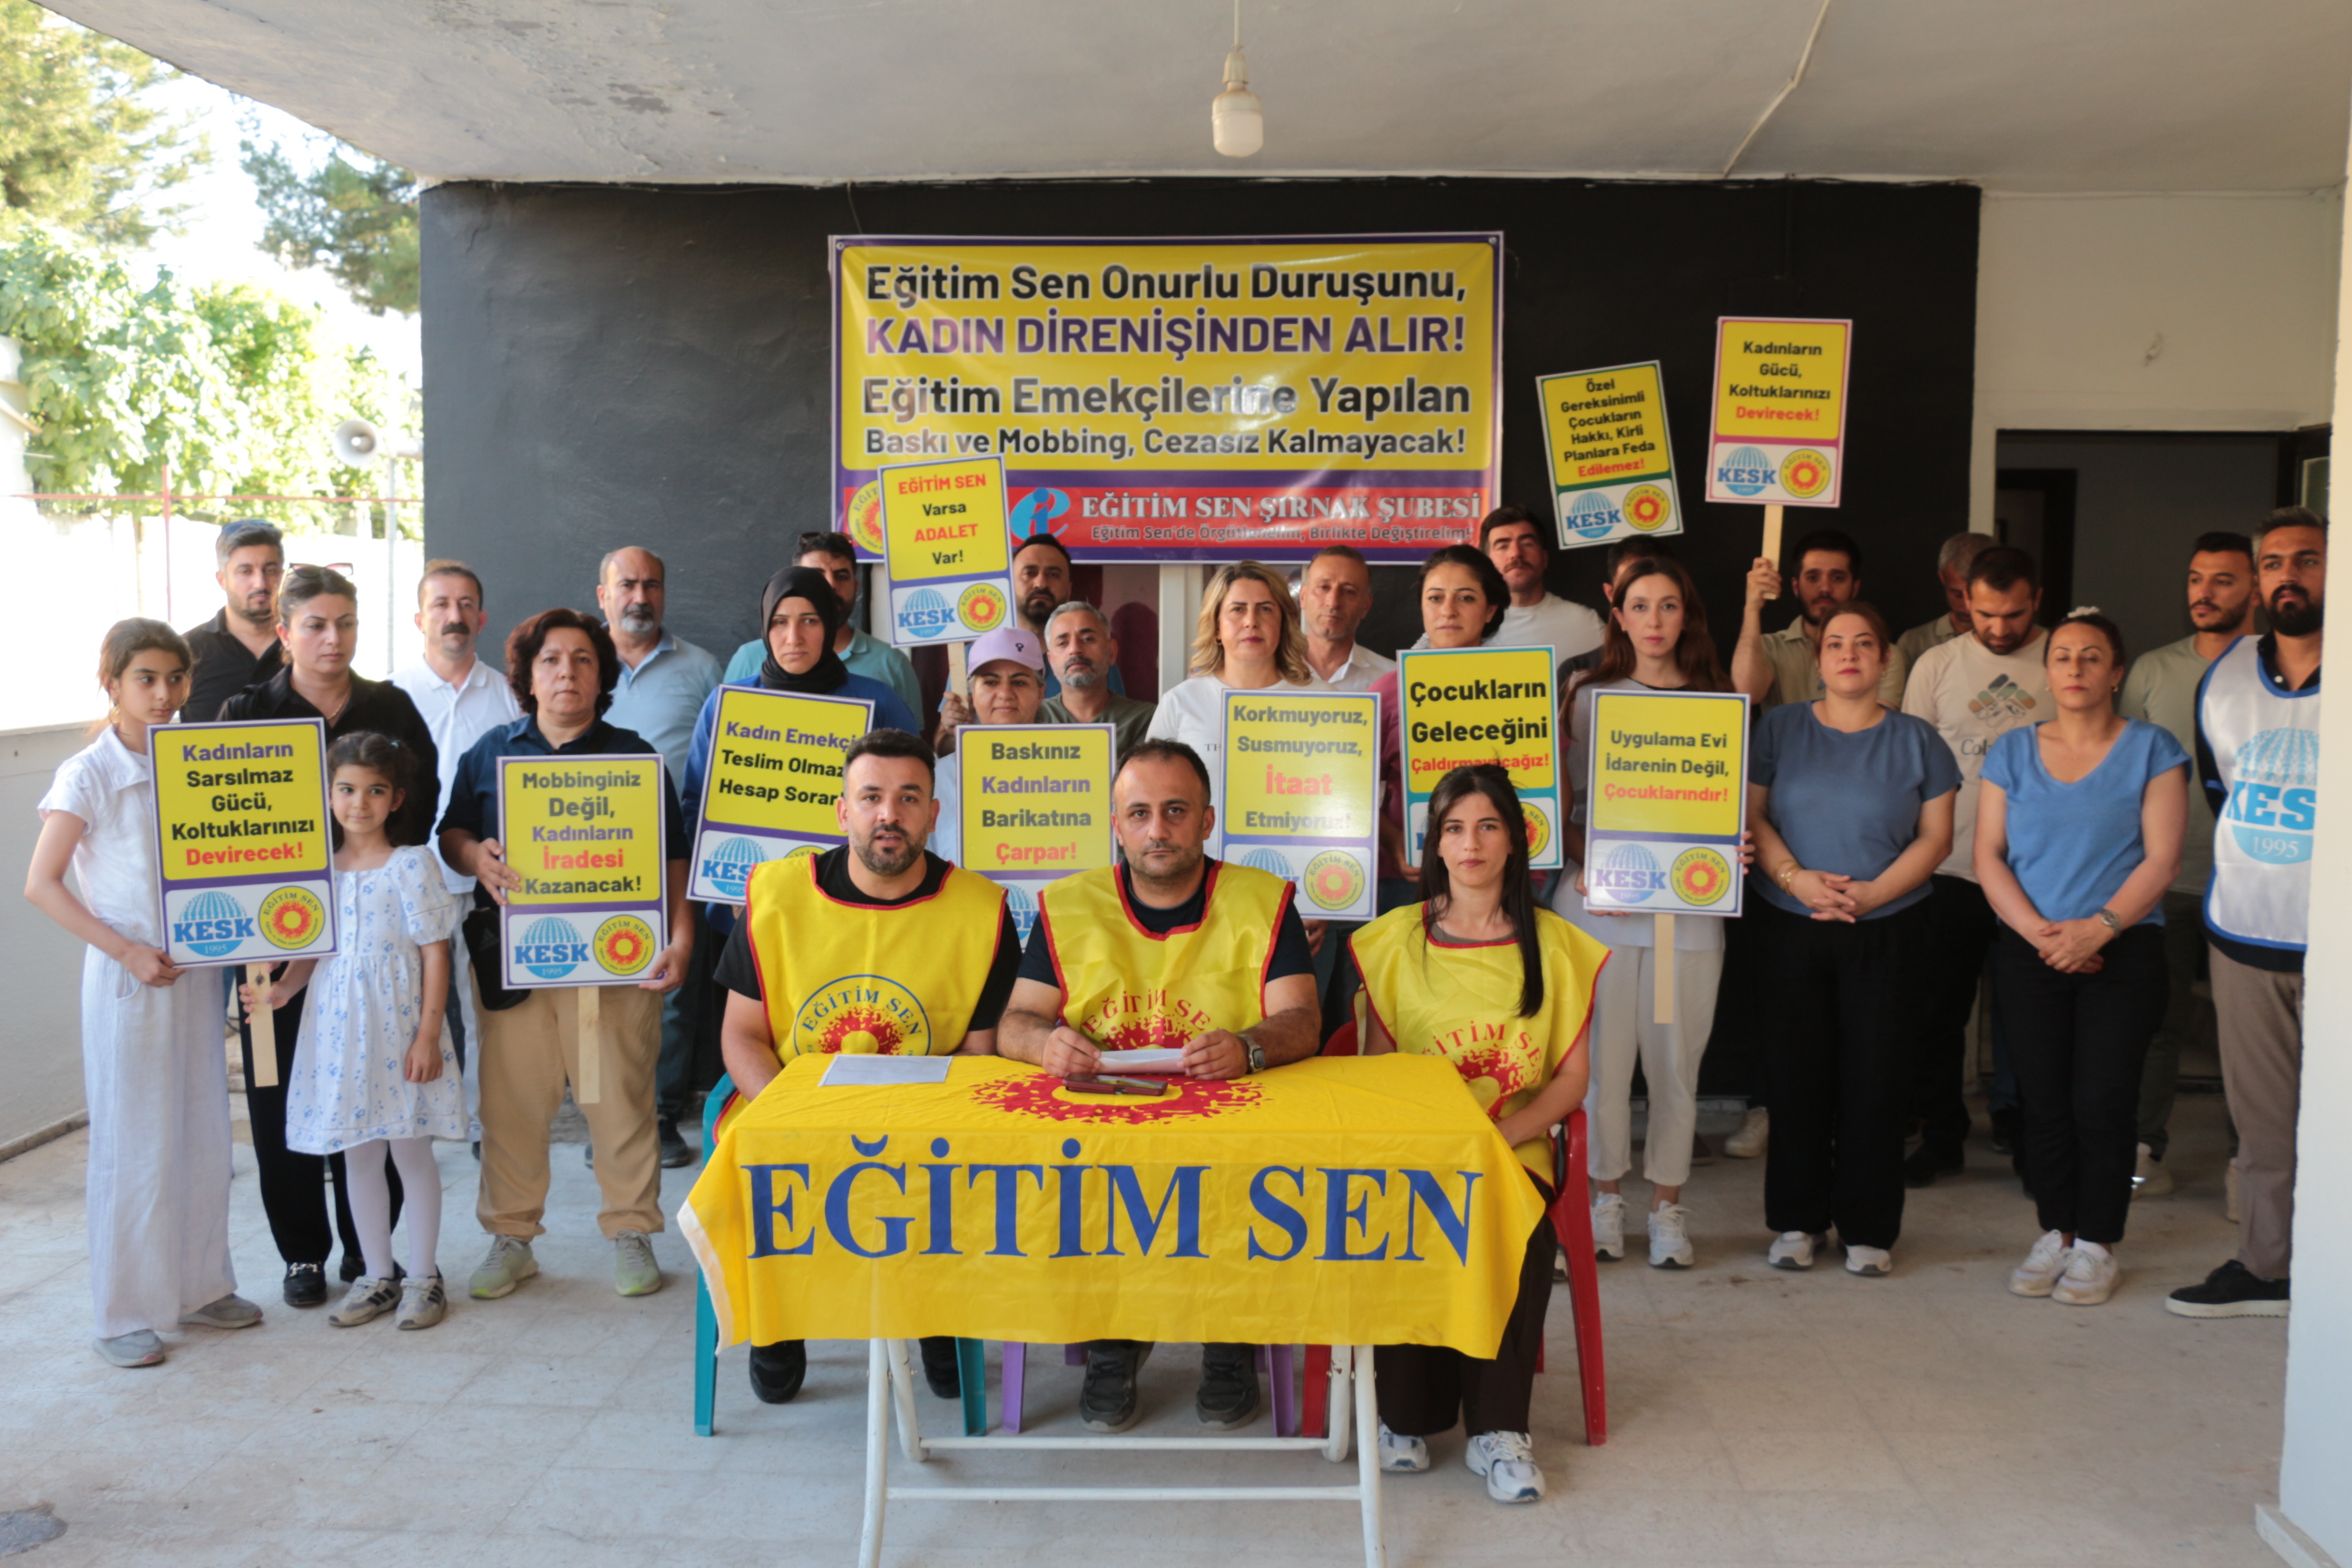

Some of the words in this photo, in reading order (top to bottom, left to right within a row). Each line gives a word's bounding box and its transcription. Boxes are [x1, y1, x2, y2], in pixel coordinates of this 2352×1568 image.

[867, 264, 999, 309] Eğitim
[1011, 264, 1090, 299] Sen
[1102, 264, 1239, 299] Onurlu
[1250, 263, 1465, 306] Duruşunu,
[867, 318, 1004, 354] KADIN
[1016, 307, 1331, 362] DİRENİŞİNDEN
[1343, 317, 1465, 353] ALIR!
[1744, 341, 1822, 355] Kadınların
[1760, 364, 1802, 377] Gücü,
[1586, 378, 1615, 392] Özel
[1730, 384, 1830, 399] Koltuklarınızı
[864, 376, 1001, 423] Eğitim
[1013, 375, 1298, 422] Emekçilerine
[1309, 377, 1470, 422] Yapılan
[1561, 391, 1645, 413] Gereksinimli
[1569, 410, 1642, 430] Çocukların
[1736, 407, 1819, 420] Devirecek!
[866, 428, 947, 454] Baskı
[956, 434, 991, 454] ve
[998, 427, 1135, 460] Mobbing,
[1143, 428, 1259, 454] Cezasız
[1268, 427, 1465, 460] Kalmayacak!
[1572, 431, 1612, 445] Hakkı,
[1616, 425, 1643, 438] Kirli
[1564, 446, 1620, 462] Planlara
[1622, 441, 1655, 455] Feda
[1578, 458, 1644, 477] Edilemez!
[1718, 467, 1776, 484] KESK
[898, 475, 951, 495] EĞİTİM
[956, 474, 986, 488] SEN
[854, 487, 877, 511] EĞİT
[1081, 492, 1188, 517] EĞİTİM
[1195, 496, 1252, 518] SEN
[1259, 496, 1371, 523] ŞIRNAK
[1378, 493, 1481, 523] ŞUBESİ
[923, 503, 966, 516] Varsa
[1566, 509, 1622, 529] KESK
[915, 524, 978, 542] ADALET
[1093, 525, 1140, 541] Eğitim
[1145, 526, 1194, 539] Sen'de
[1310, 526, 1366, 539] Birlikte
[1371, 526, 1471, 542] Değiştirelim!
[932, 550, 963, 564] Var!
[898, 608, 955, 627] KESK
[1410, 680, 1546, 708] Çocukların
[1234, 705, 1367, 726] Korkmuyoruz,
[726, 721, 780, 741] Kadın
[1412, 716, 1548, 745] Geleceğini
[1611, 730, 1695, 748] Uygulama
[1700, 733, 1727, 749] Evi
[182, 742, 294, 762] Kadınların
[991, 742, 1081, 760] Baskınız
[1238, 736, 1362, 757] Susmuyoruz,
[721, 750, 783, 770] Teslim
[1606, 753, 1676, 773] İdarenin
[1681, 760, 1729, 778] Değil,
[187, 769, 293, 787] Sarsılmaz
[523, 771, 642, 791] Mobbinginiz
[982, 776, 1091, 793] Kadınların
[1266, 764, 1333, 795] İtaat
[211, 792, 272, 811] Gücü,
[720, 779, 779, 802] Hesap
[784, 786, 843, 806] Sorar
[1604, 783, 1728, 802] Çocuklarındır!
[549, 797, 615, 820] Değil,
[2226, 780, 2317, 830] KES
[982, 808, 1092, 827] Barikatına
[1246, 811, 1351, 832] Etmiyoruz!
[172, 820, 314, 840] Koltuklarınızı
[533, 825, 633, 842] Kadınların
[186, 841, 303, 866] Devirecek!
[544, 846, 623, 869] İradesi
[996, 842, 1076, 865] Çarpar!
[2253, 837, 2299, 858] 1995
[701, 860, 751, 881] KES
[1595, 869, 1666, 889] KESK
[525, 876, 642, 895] Kazanacak!
[173, 917, 255, 943] KESK
[204, 944, 228, 954] 1995
[514, 943, 589, 965] KESK
[542, 966, 563, 976] 1995
[802, 985, 880, 1032] EĞİTİM
[886, 997, 922, 1035] SEN
[1083, 989, 1167, 1034] EĞİTİM
[1175, 999, 1210, 1032] SE
[1422, 1020, 1506, 1055] İTİM
[741, 1133, 1212, 1260] EĞİTİM
[1247, 1165, 1484, 1267] SEN
